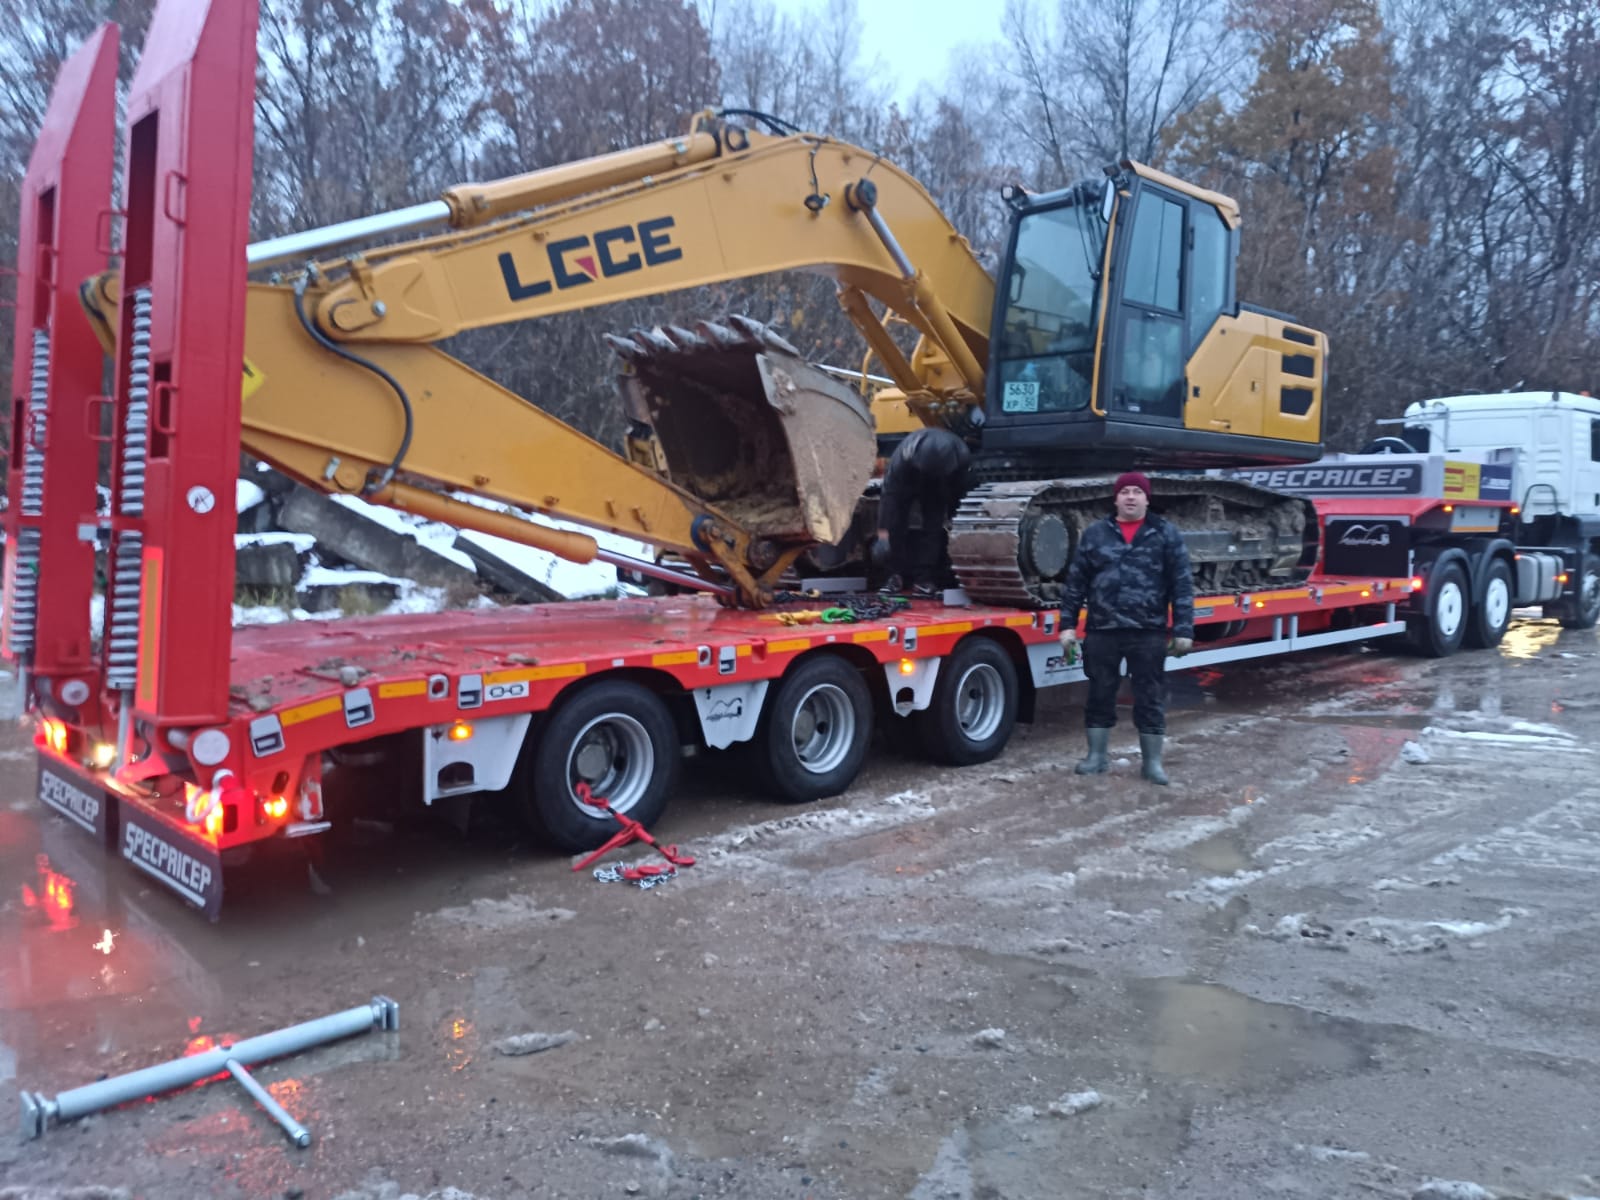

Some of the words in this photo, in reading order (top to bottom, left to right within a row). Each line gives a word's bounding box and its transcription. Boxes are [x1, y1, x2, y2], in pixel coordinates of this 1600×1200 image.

[1008, 383, 1036, 396] 5630
[40, 770, 99, 822] SPECPRICEP
[123, 821, 212, 894] SPECPRICEP
